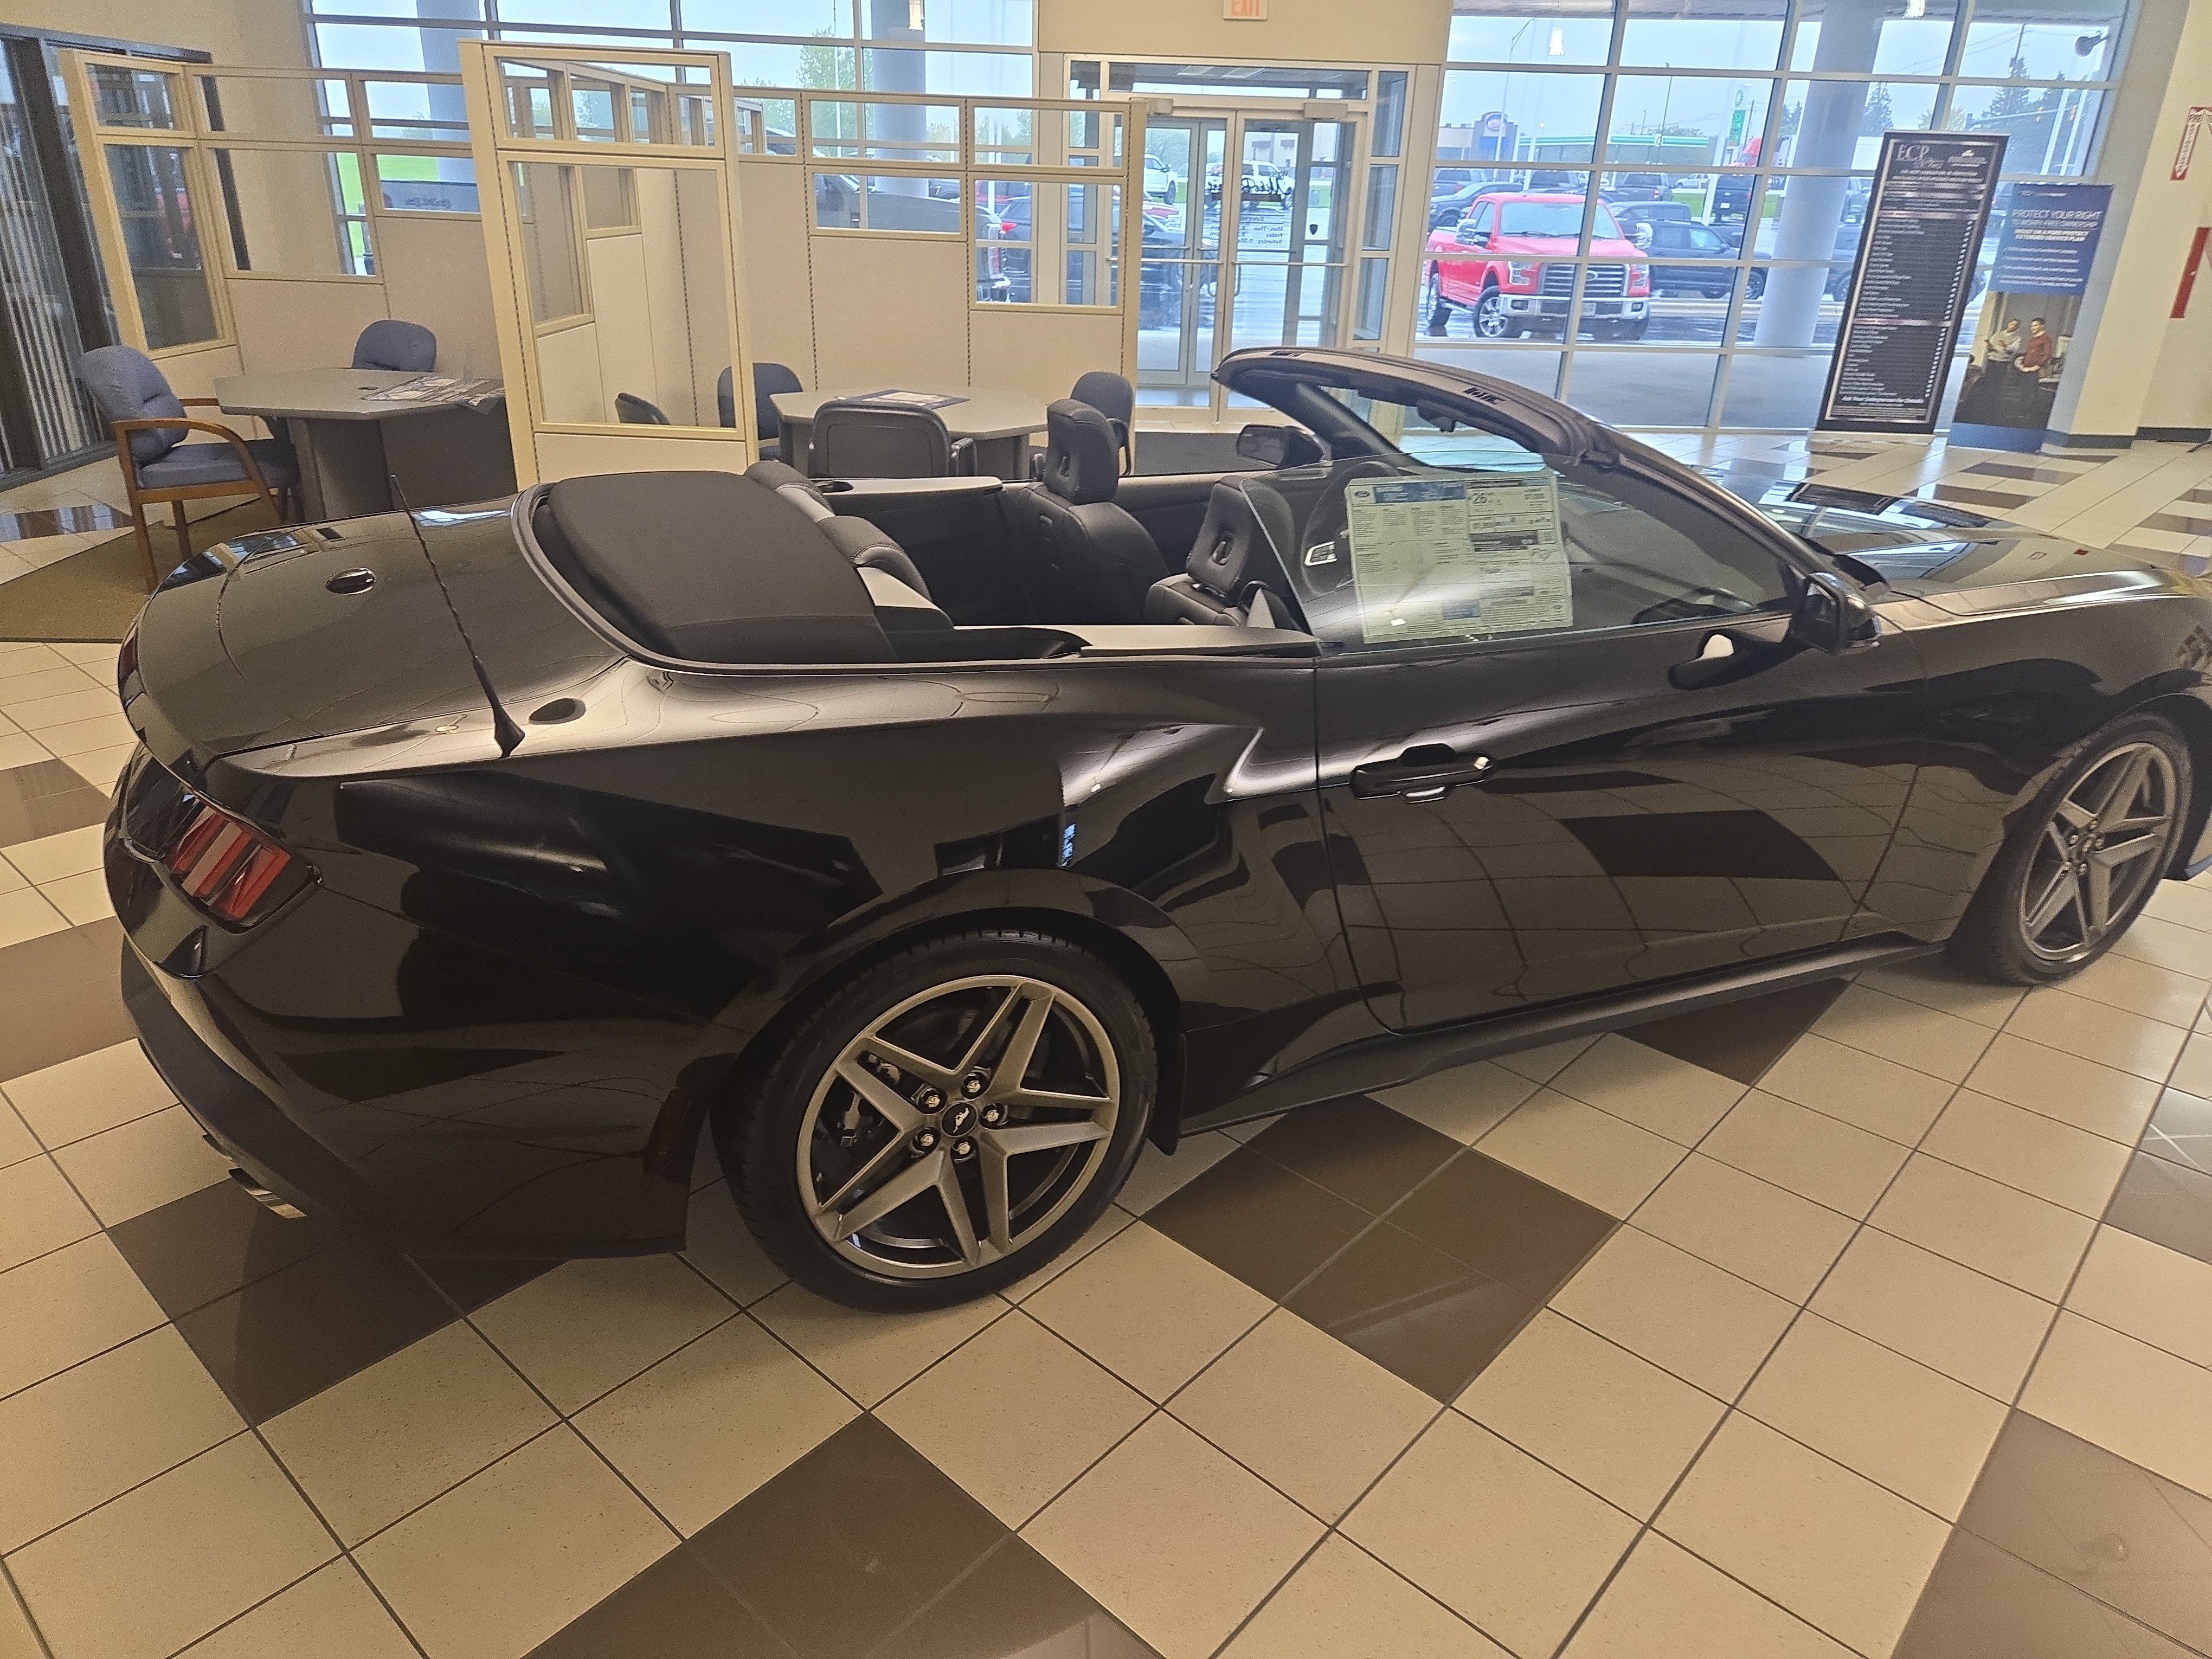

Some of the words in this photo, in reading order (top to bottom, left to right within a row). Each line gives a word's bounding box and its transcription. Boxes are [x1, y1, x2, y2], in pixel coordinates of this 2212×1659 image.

[2011, 209, 2050, 218] PROTECT
[2052, 210, 2075, 219] YOUR
[2075, 210, 2103, 220] RIGHT
